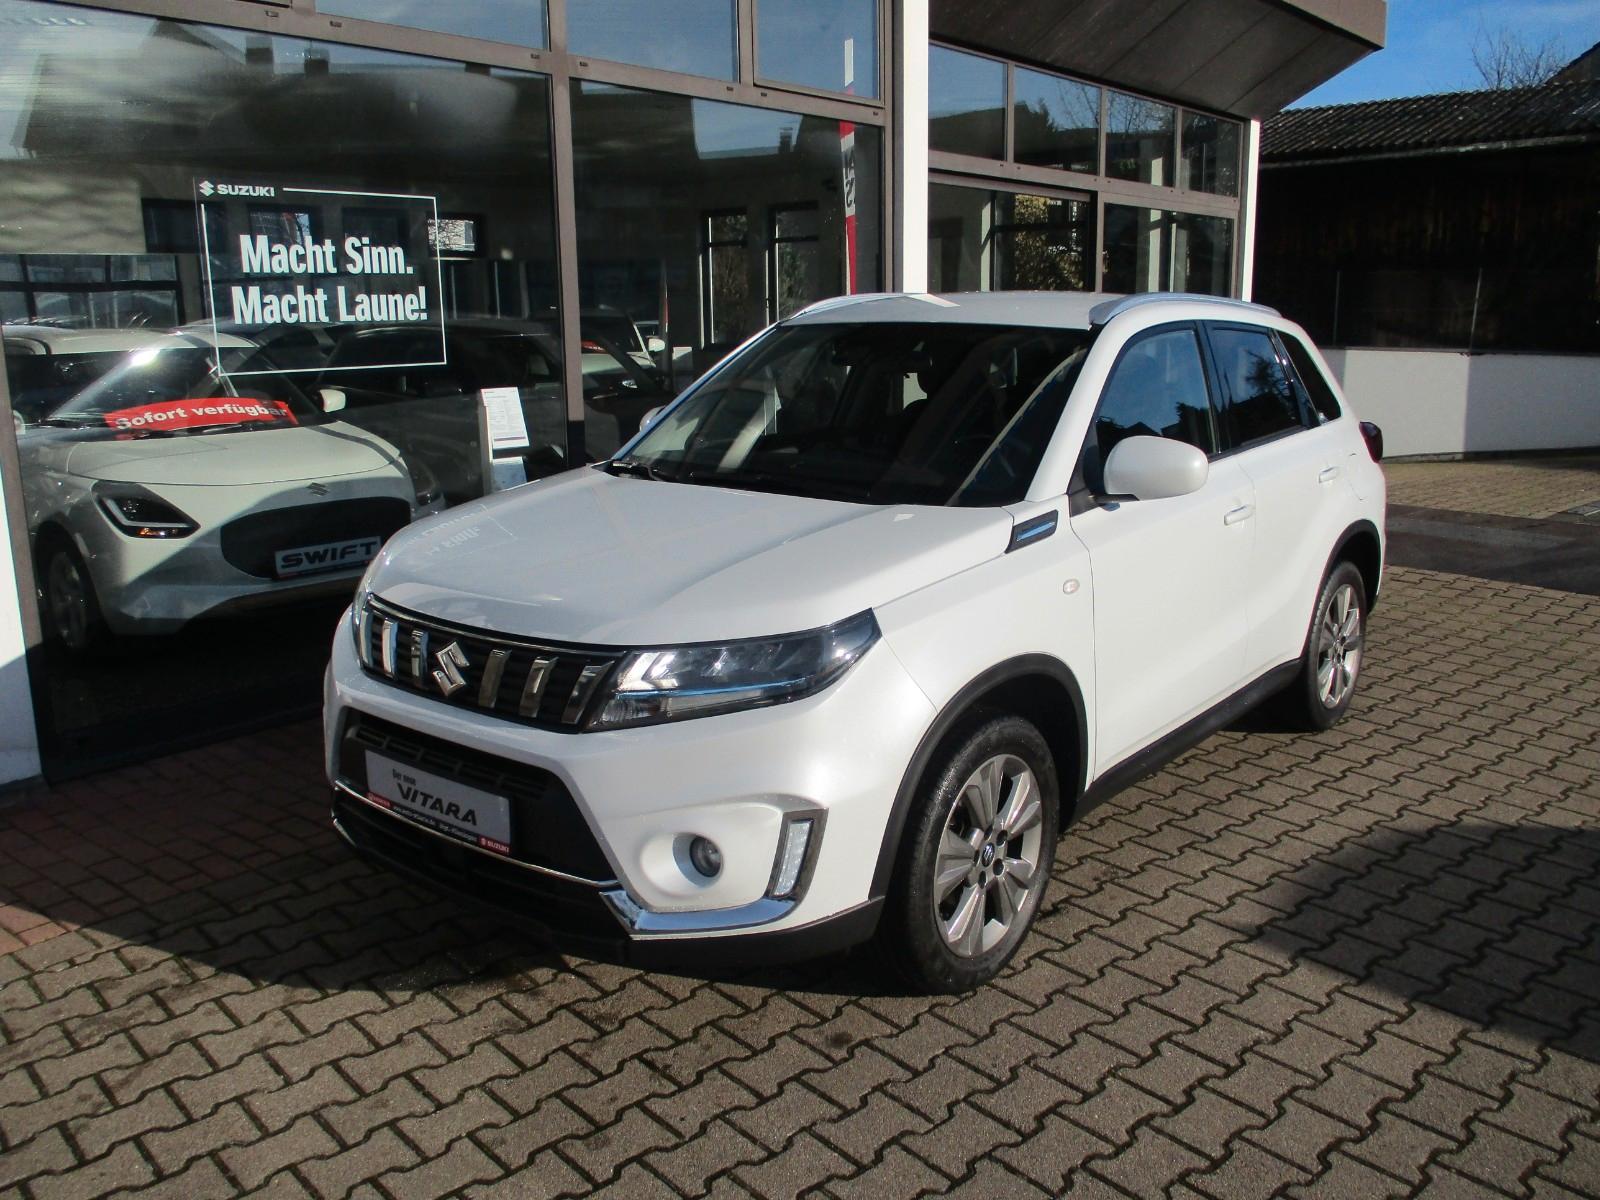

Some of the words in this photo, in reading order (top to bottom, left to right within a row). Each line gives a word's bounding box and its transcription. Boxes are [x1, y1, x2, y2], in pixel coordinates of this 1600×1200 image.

[217, 184, 275, 197] SUZUKI
[239, 234, 337, 274] Macht
[344, 236, 413, 274] Sinn.
[231, 285, 330, 324] Macht
[337, 285, 428, 322] Laune!
[115, 407, 188, 430] Sofort
[191, 403, 288, 418] verfügbar
[281, 541, 378, 569] SWIFT
[397, 782, 477, 826] VITARA
